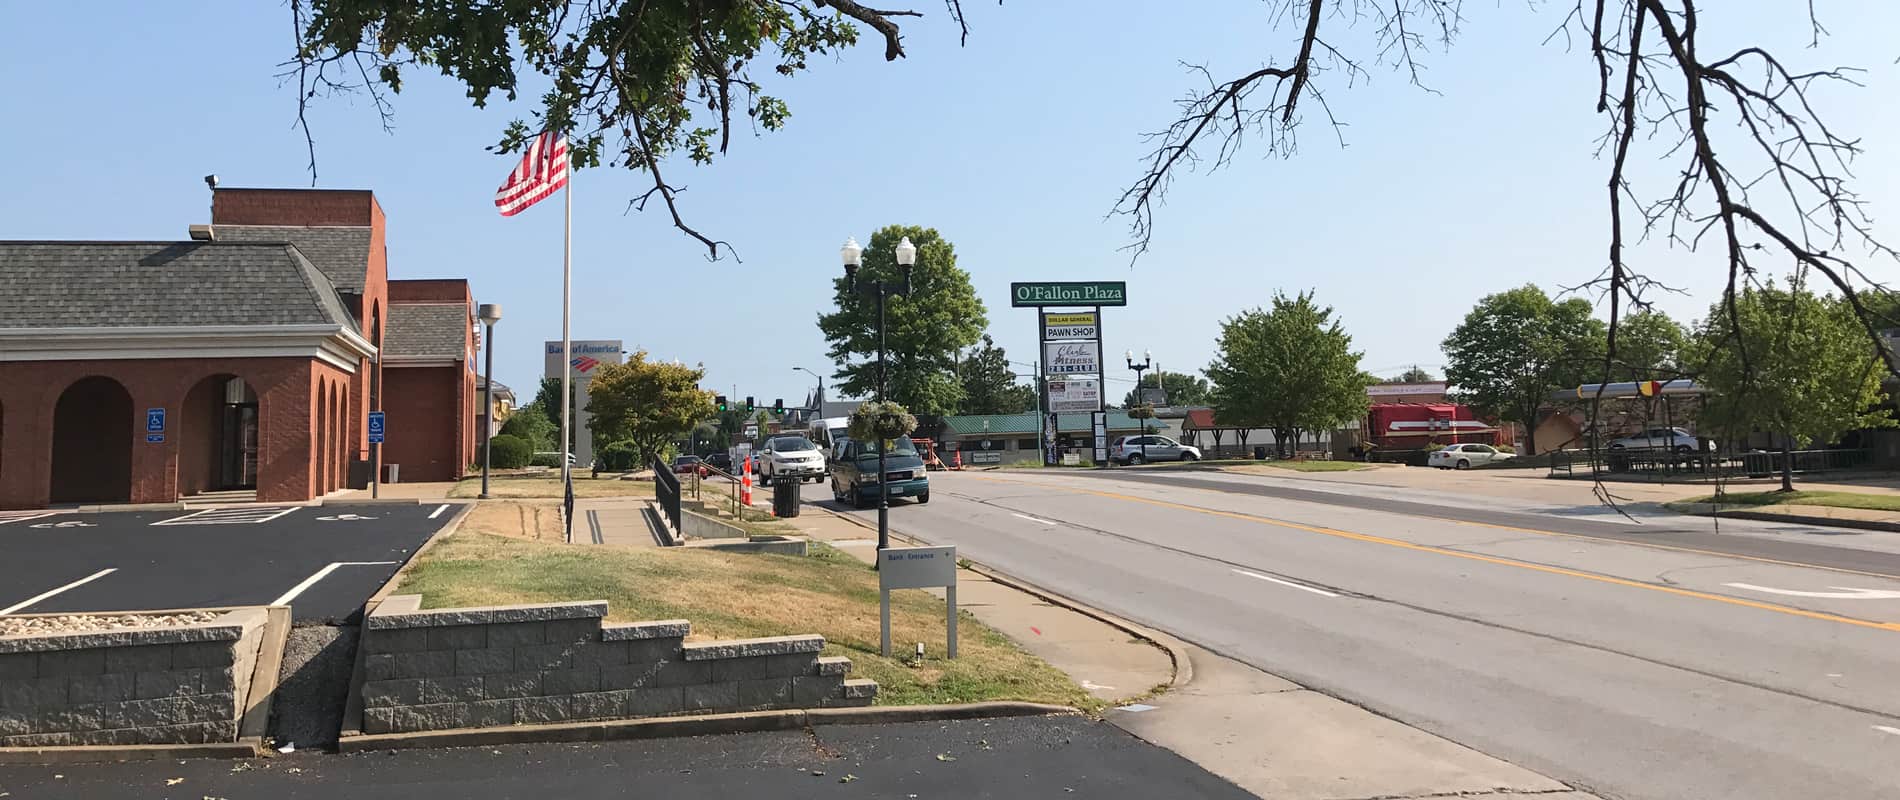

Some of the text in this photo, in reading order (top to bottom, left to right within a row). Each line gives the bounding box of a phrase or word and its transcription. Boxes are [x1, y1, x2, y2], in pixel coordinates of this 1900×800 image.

[1017, 286, 1122, 300] O'Fallon Plaza
[1048, 327, 1095, 337] PAWN SHOP
[572, 344, 582, 353] of
[582, 344, 619, 353] America
[908, 552, 934, 560] Entrance
